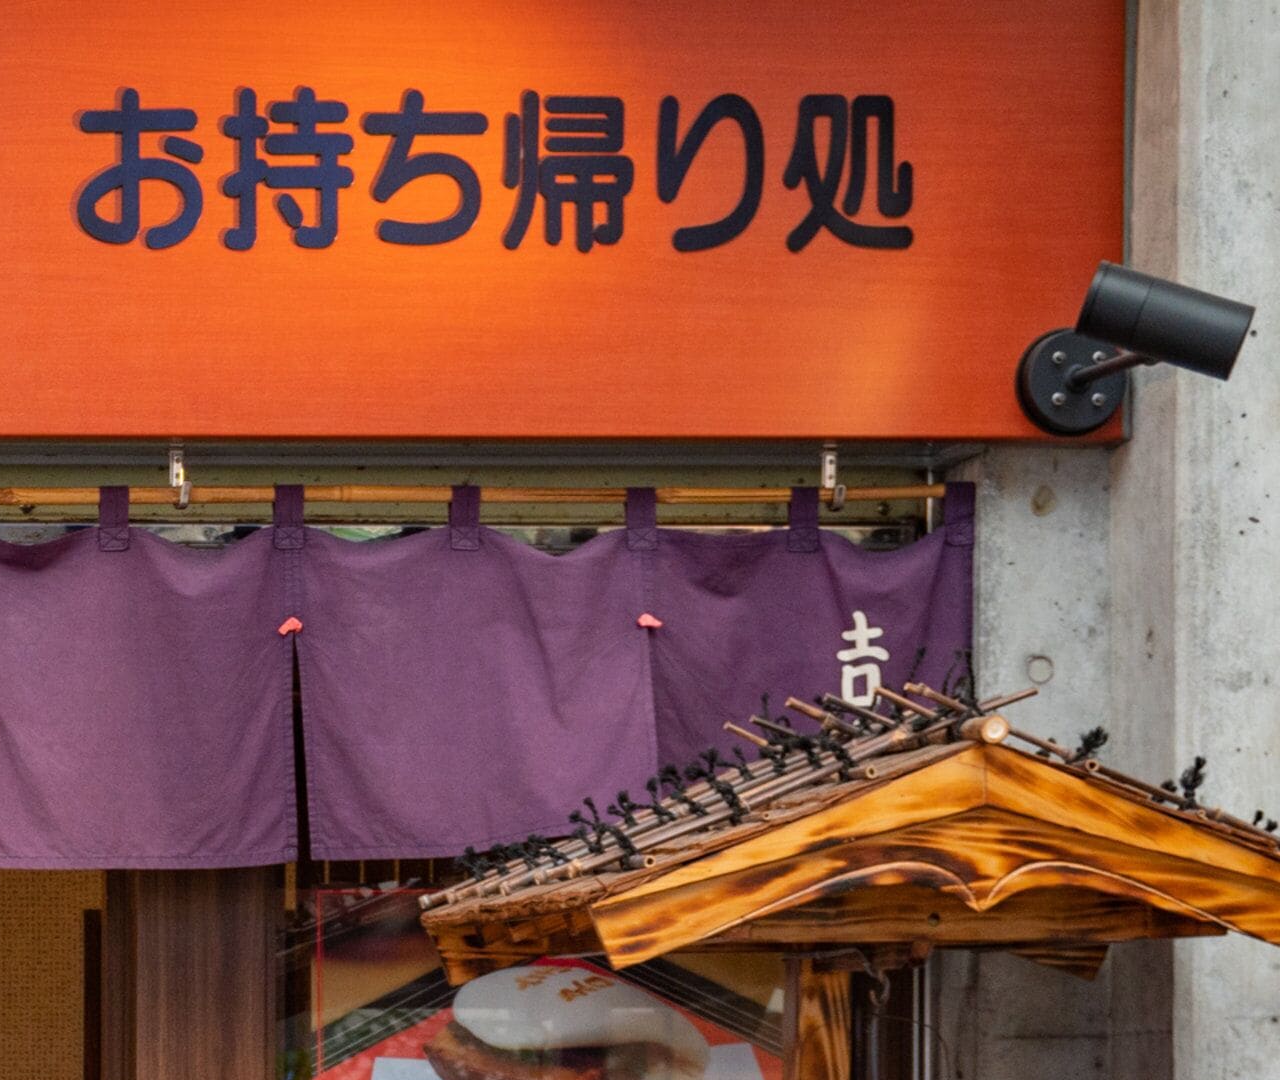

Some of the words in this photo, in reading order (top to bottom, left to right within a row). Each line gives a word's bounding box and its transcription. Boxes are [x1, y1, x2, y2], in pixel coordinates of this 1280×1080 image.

[68, 84, 916, 254] お持ち帰り処
